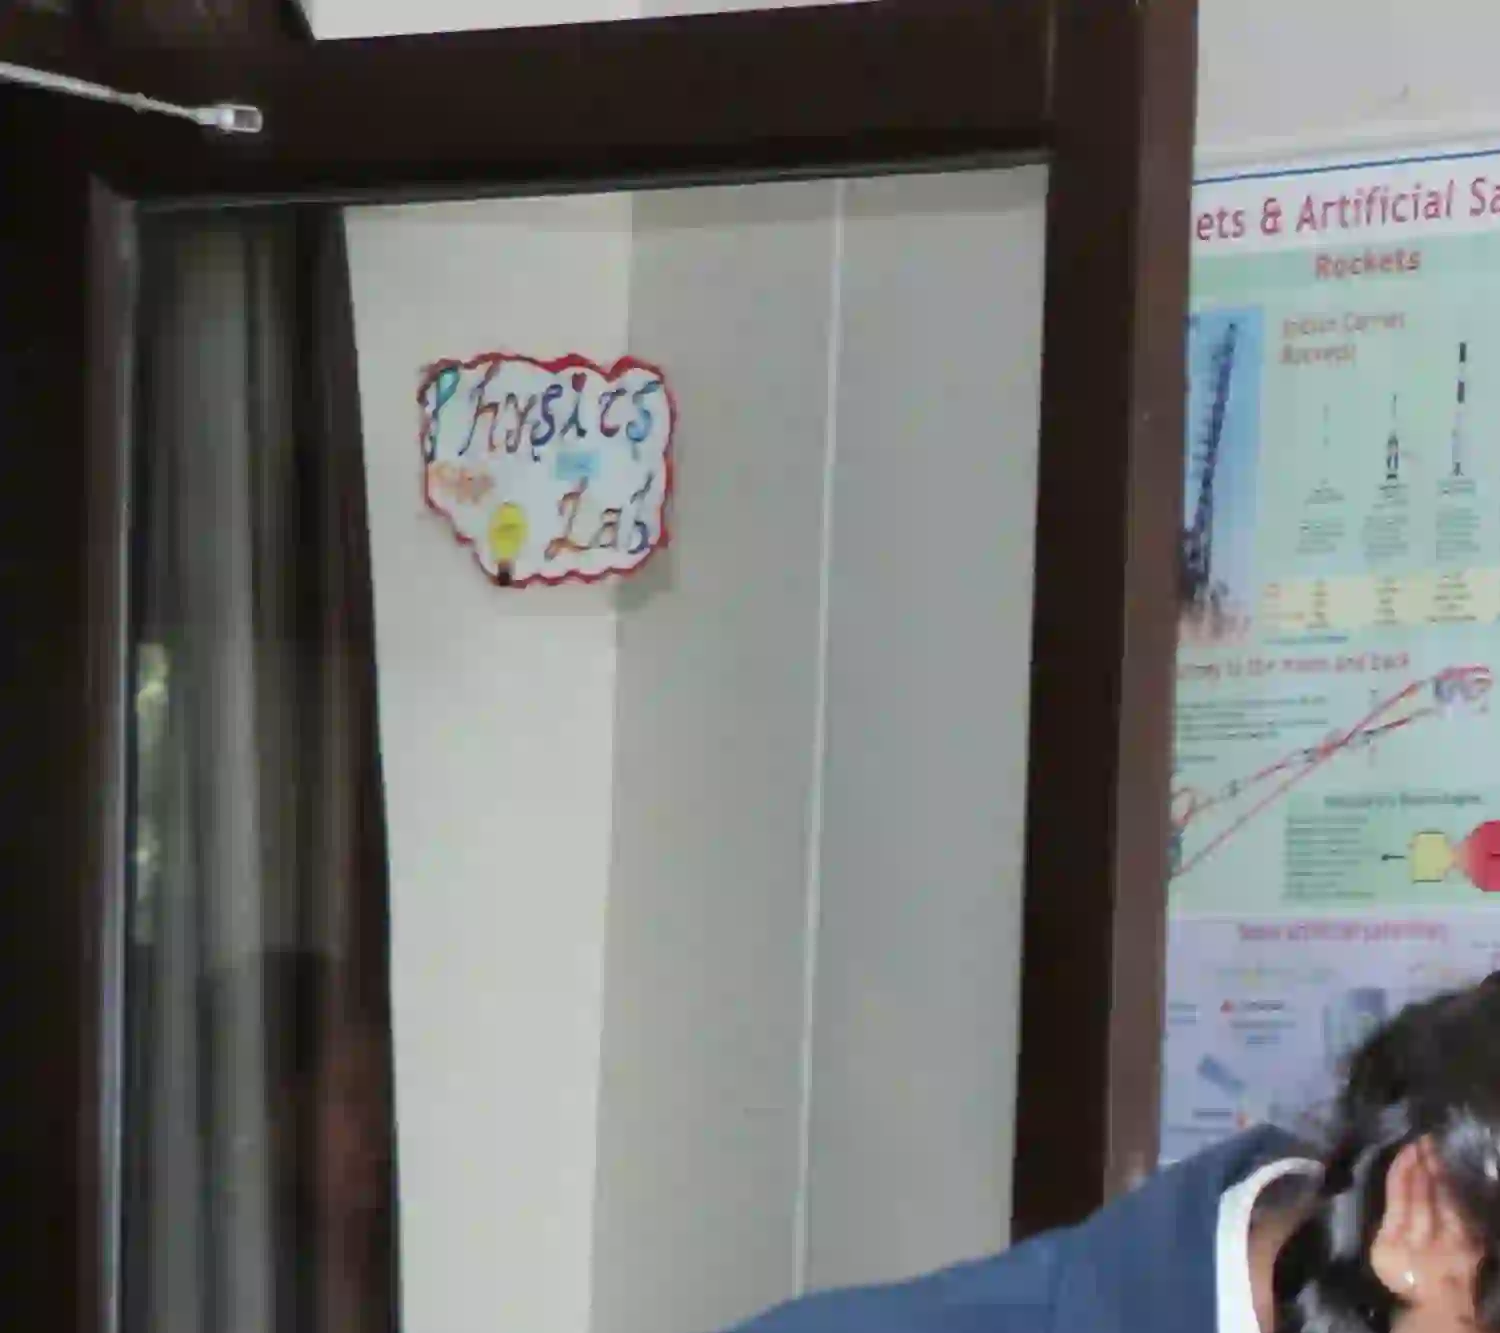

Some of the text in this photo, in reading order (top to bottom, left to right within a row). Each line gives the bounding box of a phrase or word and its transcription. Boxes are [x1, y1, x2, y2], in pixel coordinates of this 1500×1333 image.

[1196, 206, 1246, 241] ets
[1260, 197, 1283, 235] &
[1296, 178, 1455, 233] Artificial
[1315, 250, 1421, 279] Rockets
[424, 361, 663, 462] Physics
[544, 472, 654, 560] Lab
